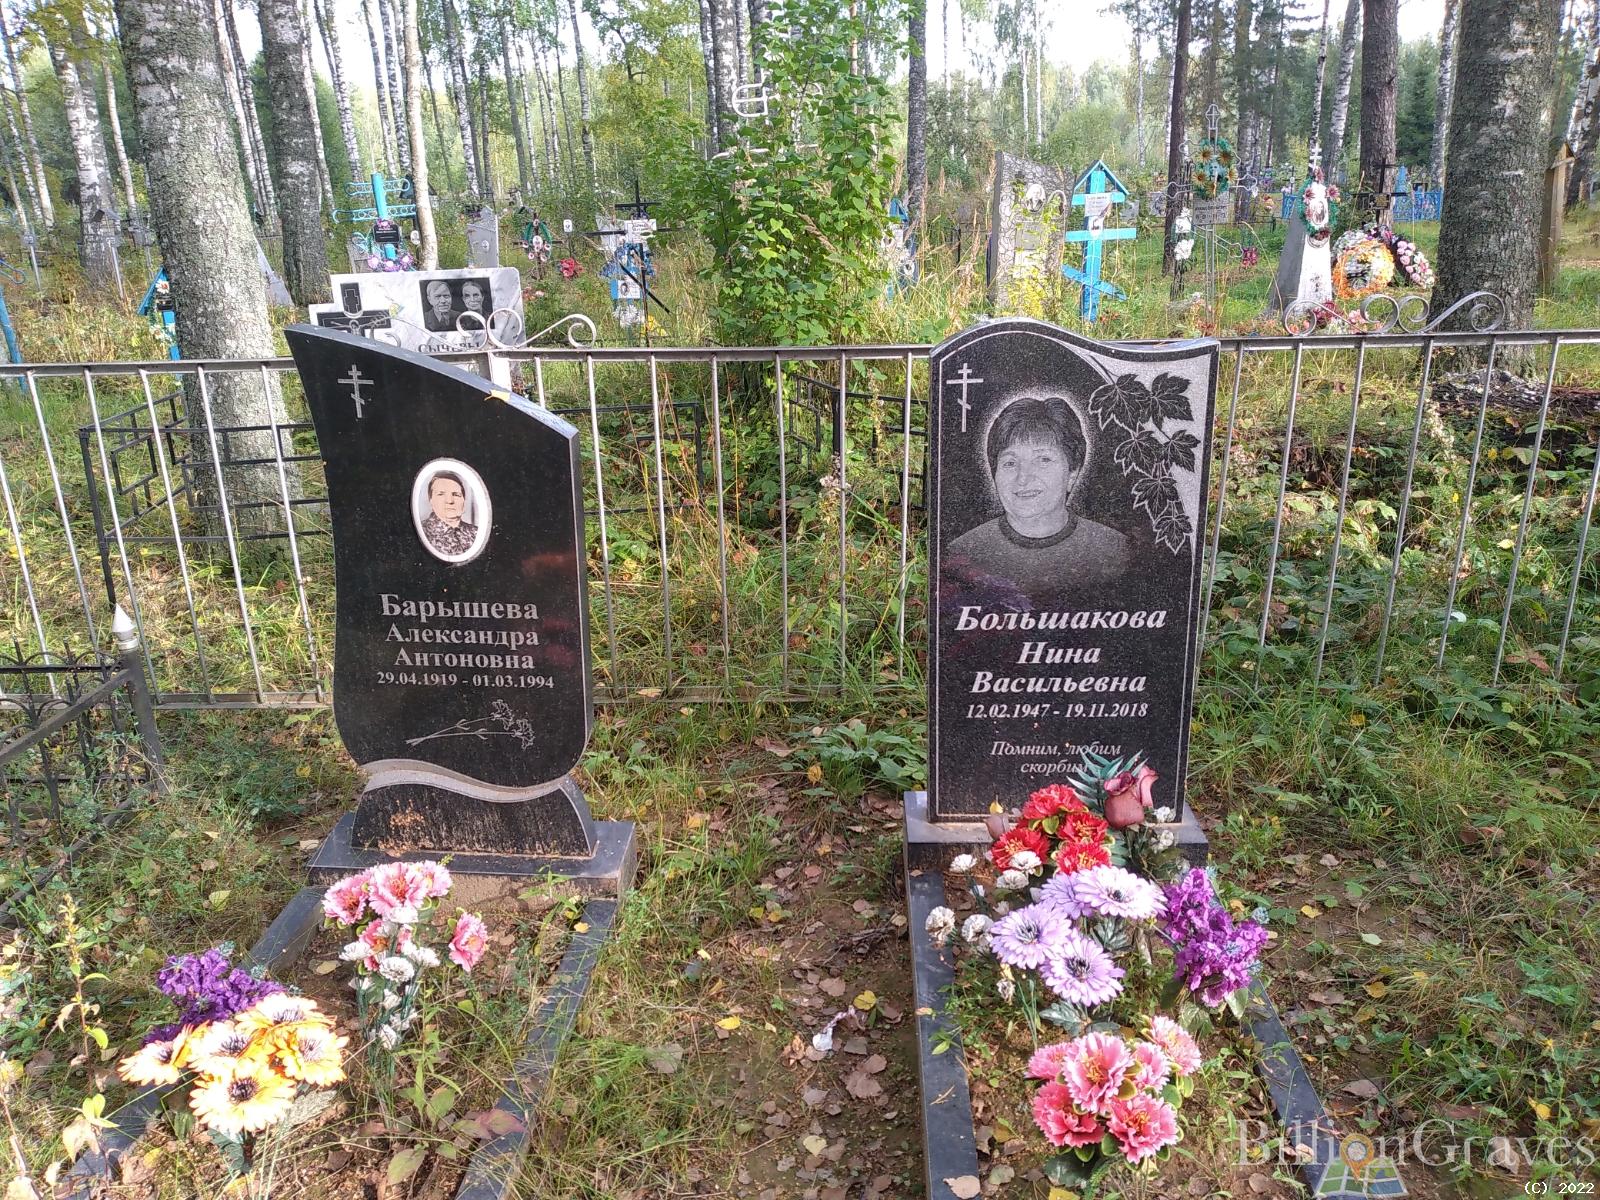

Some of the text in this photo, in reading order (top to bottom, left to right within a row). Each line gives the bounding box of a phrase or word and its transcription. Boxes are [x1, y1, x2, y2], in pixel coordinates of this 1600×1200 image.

[379, 593, 539, 623] Барышева
[954, 605, 1168, 631] Большакова
[385, 622, 540, 651] Александра
[394, 647, 536, 670] Антоновна
[1016, 641, 1102, 664] Нина
[376, 671, 458, 686] 29.04.1919
[472, 675, 555, 689] 01.03.1994
[970, 671, 1146, 693] Васильевна
[966, 704, 1050, 719] 12.02.1947
[1064, 703, 1149, 719] 19.11.2018
[990, 741, 1061, 756] Помним,
